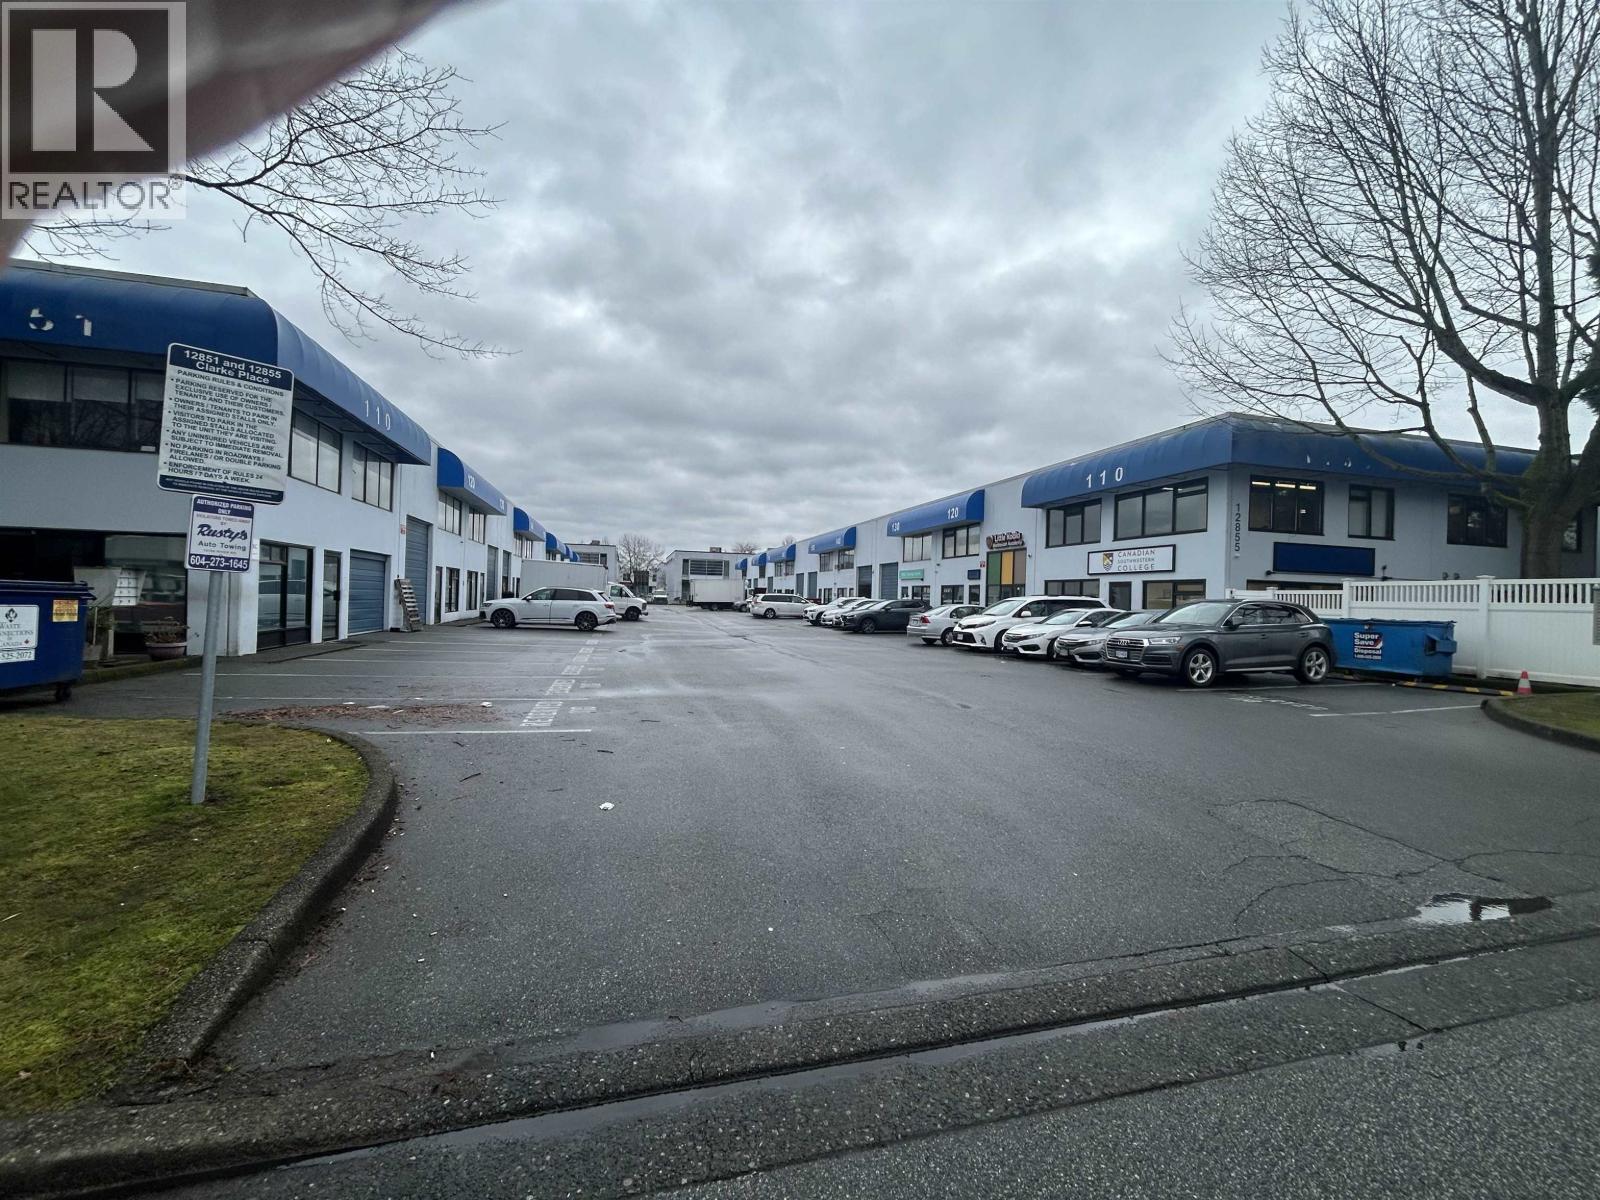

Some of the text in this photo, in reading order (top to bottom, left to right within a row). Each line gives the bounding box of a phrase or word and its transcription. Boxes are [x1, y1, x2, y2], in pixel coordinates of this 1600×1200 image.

[184, 350, 282, 379] 12851 and 12855
[196, 361, 270, 384] Clarke Place
[176, 378, 207, 389] PARKING
[209, 385, 243, 397] RESERVED
[178, 370, 210, 381] PARKING
[212, 377, 235, 386] RULES
[244, 384, 284, 397] CONDITIONS
[175, 390, 206, 400] TENANTS
[175, 384, 213, 396] EXCLUSIVE
[241, 398, 268, 407] OWNERS
[174, 397, 205, 408] OWNERS
[210, 404, 240, 414] TENANTS
[174, 403, 194, 411] THEIR
[196, 407, 230, 418] ASSIGNED
[232, 414, 256, 423] STALLS
[173, 410, 204, 420] VISITORS
[364, 399, 391, 431] 110
[173, 416, 274, 439] ASSIGNED STALLS ALLOCATED
[171, 435, 203, 445] SUBJECT
[216, 442, 251, 453] IMMEDIATE
[188, 432, 227, 443] UNINSURED
[229, 439, 260, 449] VEHICLES
[170, 448, 208, 459] FIRELANES
[226, 457, 251, 466] DOUBLE
[253, 462, 281, 471] PARKING
[183, 445, 213, 454] PARKING
[224, 452, 260, 462] ROADWAYS
[168, 461, 221, 474] ENFORCEMENT
[233, 471, 254, 479] RULES
[168, 467, 193, 476] HOURS
[1086, 467, 1123, 488] 110
[197, 498, 252, 511] AUTHORIZED PARKING
[948, 508, 959, 519] 120
[197, 523, 248, 544] Rusty's
[220, 543, 246, 551] Towing
[1118, 549, 1156, 557] CANADIAN
[1118, 564, 1156, 572] COLLEGE
[1354, 632, 1380, 640] Super
